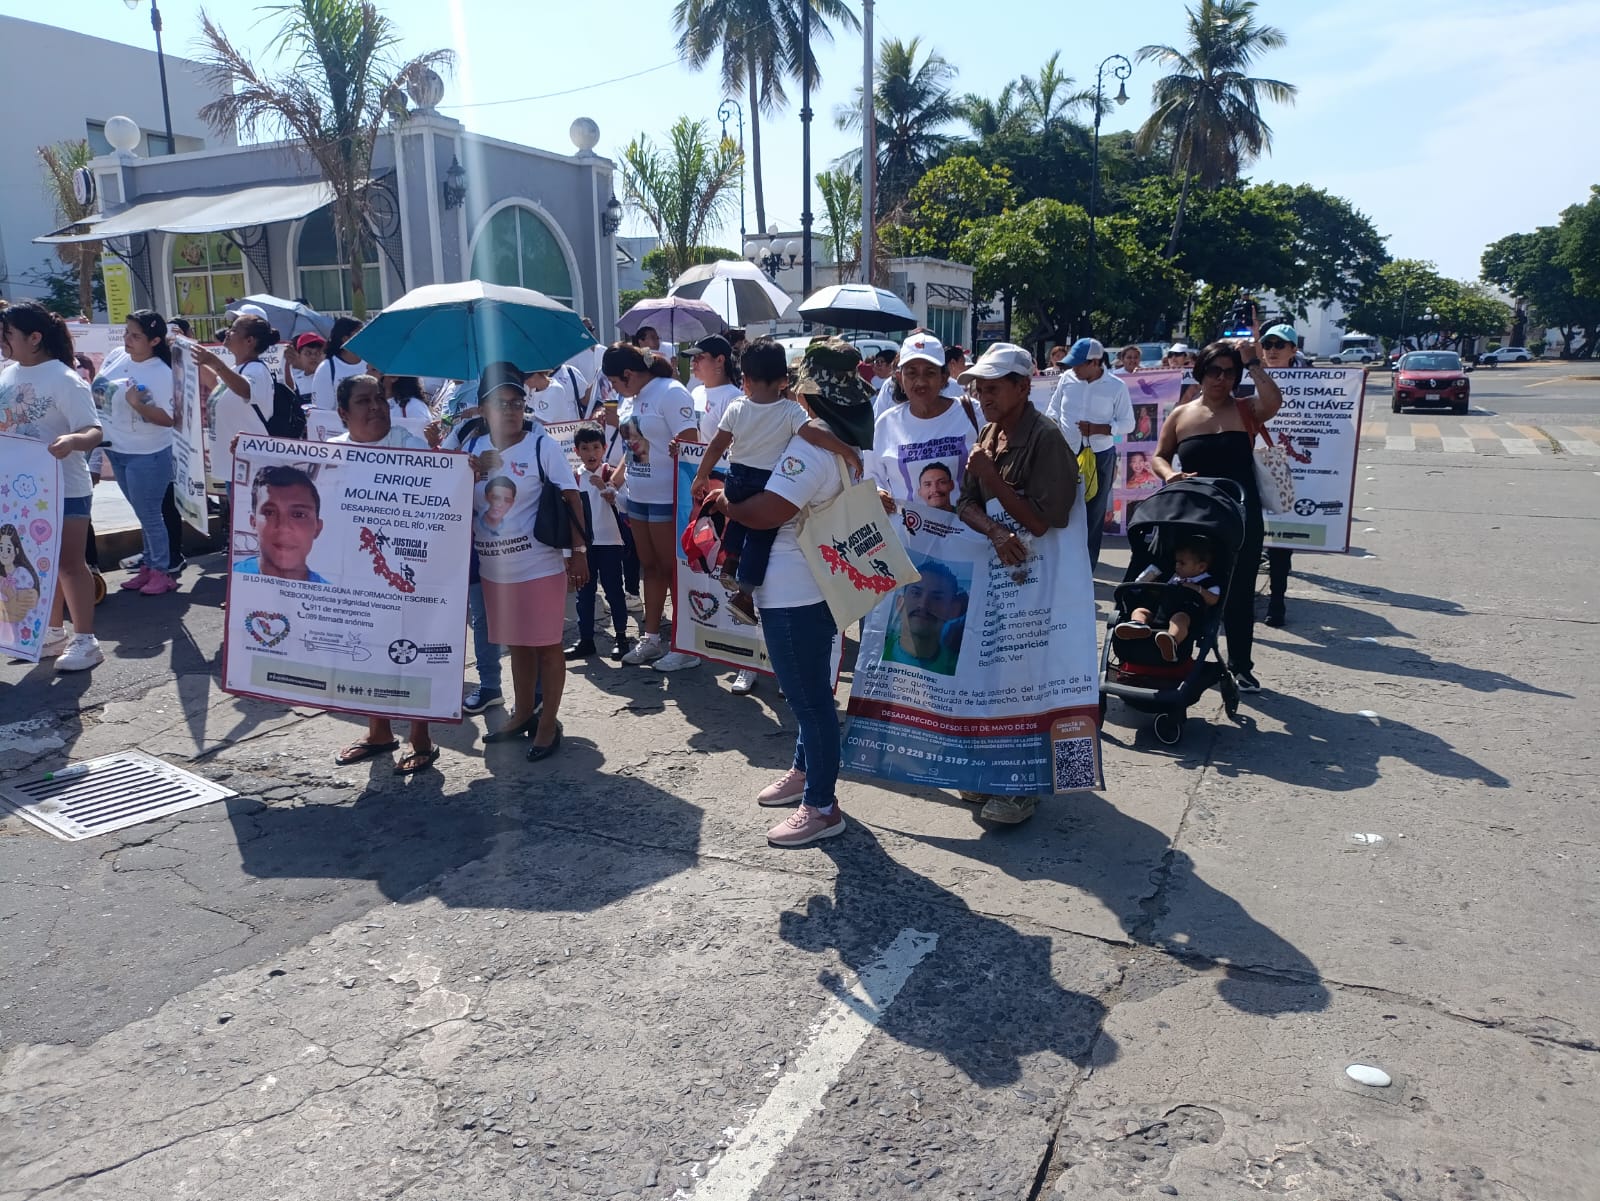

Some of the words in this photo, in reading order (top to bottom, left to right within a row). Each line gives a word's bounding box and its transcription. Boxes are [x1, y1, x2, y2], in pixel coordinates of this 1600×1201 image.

[1303, 387, 1347, 397] ISMAEL
[1307, 400, 1354, 410] CHÁVEZ
[901, 436, 963, 451] DESAPARECIDO
[242, 439, 328, 459] ¡AYÚDANOS
[332, 449, 342, 460] A
[347, 450, 453, 469] ENCONTRARLO!
[374, 473, 432, 488] ENRIQUE
[344, 488, 398, 504] MOLINA
[402, 493, 451, 507] TEJEDA
[341, 503, 400, 516] DESAPARECIÓ
[414, 511, 462, 521] 24/11/2023
[367, 517, 391, 527] BOCA
[393, 520, 410, 528] DEL
[411, 521, 425, 530] RÍO
[391, 537, 422, 548] JUSTICIA
[485, 535, 529, 549] RAYMUNDO
[848, 523, 873, 549] JUSTICIA
[501, 542, 533, 555] VIRGEN
[853, 531, 883, 558] DIGNIDAD
[394, 547, 428, 558] DIGNIDAD
[250, 575, 260, 583] LO
[260, 576, 275, 585] HAS
[298, 582, 322, 592] TIENES
[323, 585, 351, 595] ALGUNA
[352, 589, 402, 601] INFORMACIÓN
[404, 595, 439, 604] ESCRIBE
[1001, 590, 1019, 599] 1987
[309, 604, 321, 612] 911
[332, 608, 371, 618] emergencia
[370, 601, 402, 611] Veracruz
[1009, 609, 1027, 619] café
[344, 618, 374, 628] anónima
[1008, 619, 1043, 630] morena
[1008, 653, 1024, 662] Ver
[887, 666, 938, 684] particulares:
[893, 676, 906, 684] por
[910, 680, 956, 696] quemadura
[958, 689, 969, 697] de
[1020, 685, 1034, 693] del
[1069, 675, 1080, 684] de
[1083, 674, 1092, 682] la
[892, 685, 920, 696] costilla
[922, 691, 962, 704] fracturada
[964, 698, 974, 706] de
[1061, 684, 1092, 695] imagen
[922, 701, 953, 713] espalda.
[881, 710, 939, 727] DESAPARECIDO
[979, 724, 990, 732] DE
[992, 723, 1013, 731] MAYO
[1015, 722, 1025, 730] DE
[847, 736, 896, 752] CONTACTO
[906, 748, 924, 759] 228
[925, 751, 943, 762] 319
[944, 755, 969, 765] 3187
